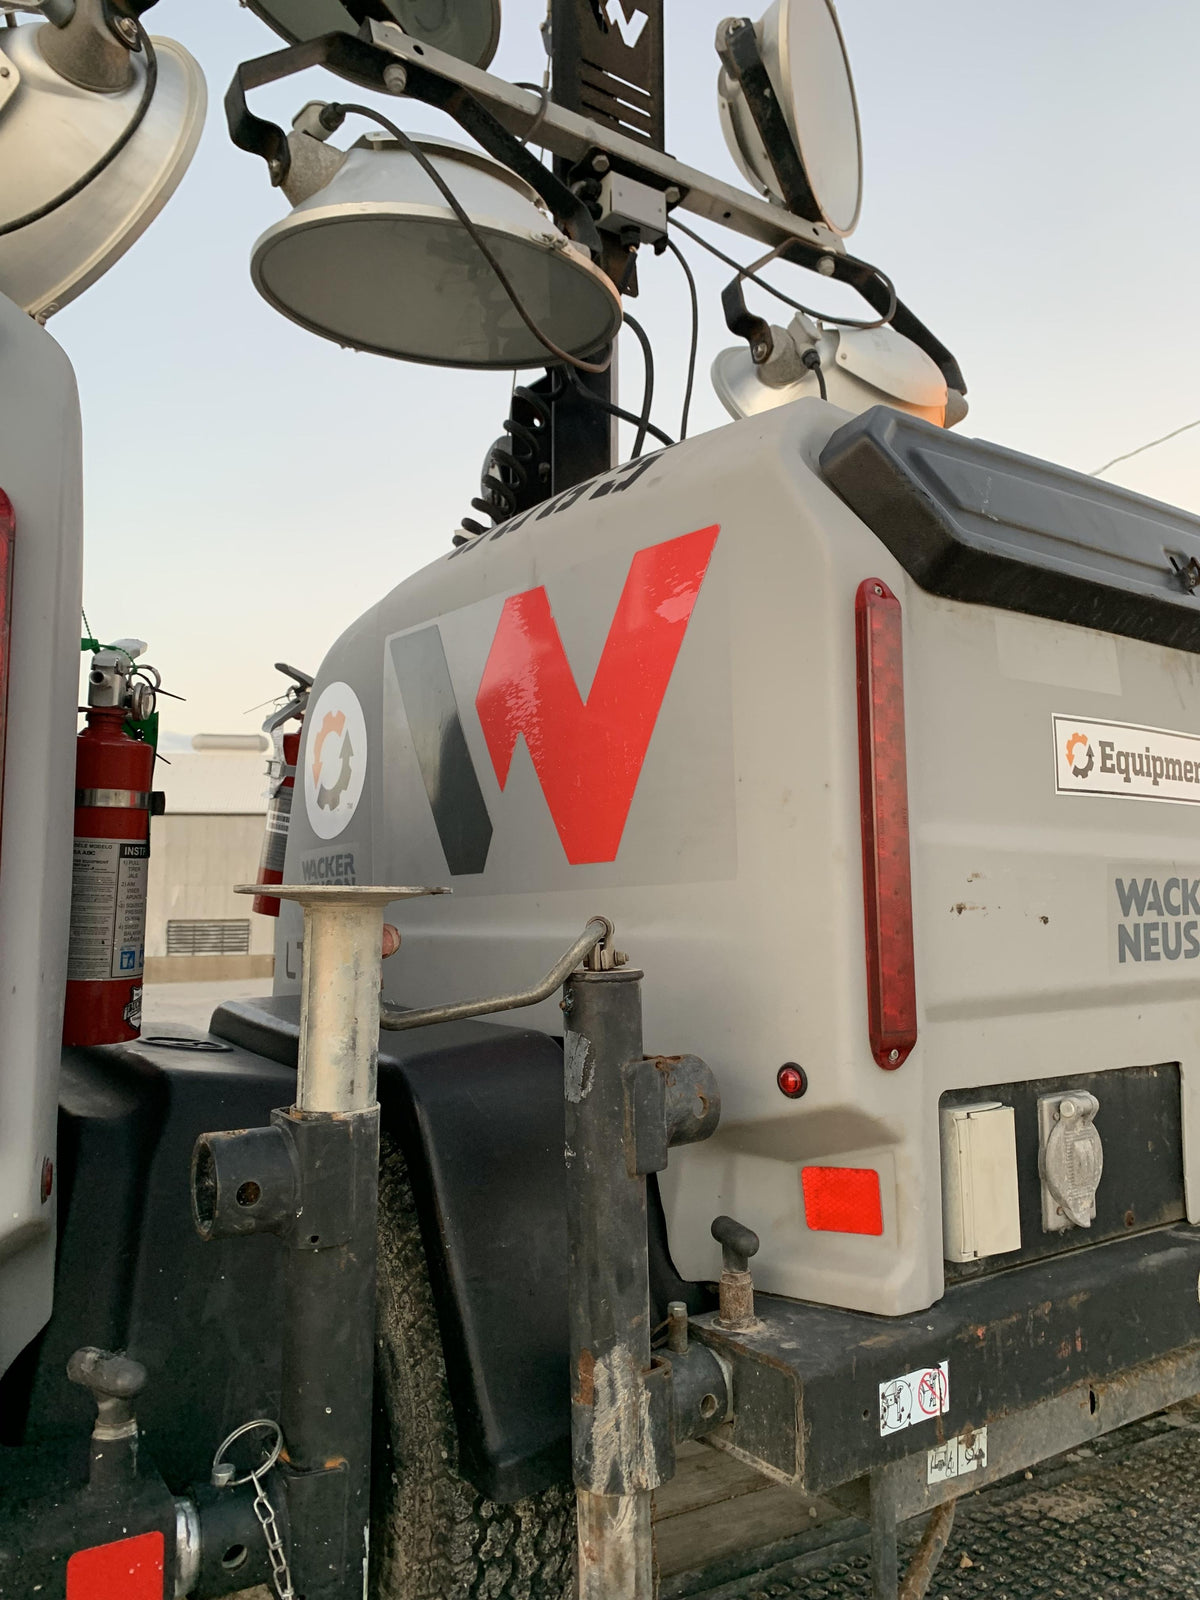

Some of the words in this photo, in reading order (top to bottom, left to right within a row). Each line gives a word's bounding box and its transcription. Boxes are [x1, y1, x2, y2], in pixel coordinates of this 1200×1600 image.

[302, 852, 356, 881] WACKER
[1115, 877, 1200, 917] WACK
[1118, 920, 1200, 963] NEUS
